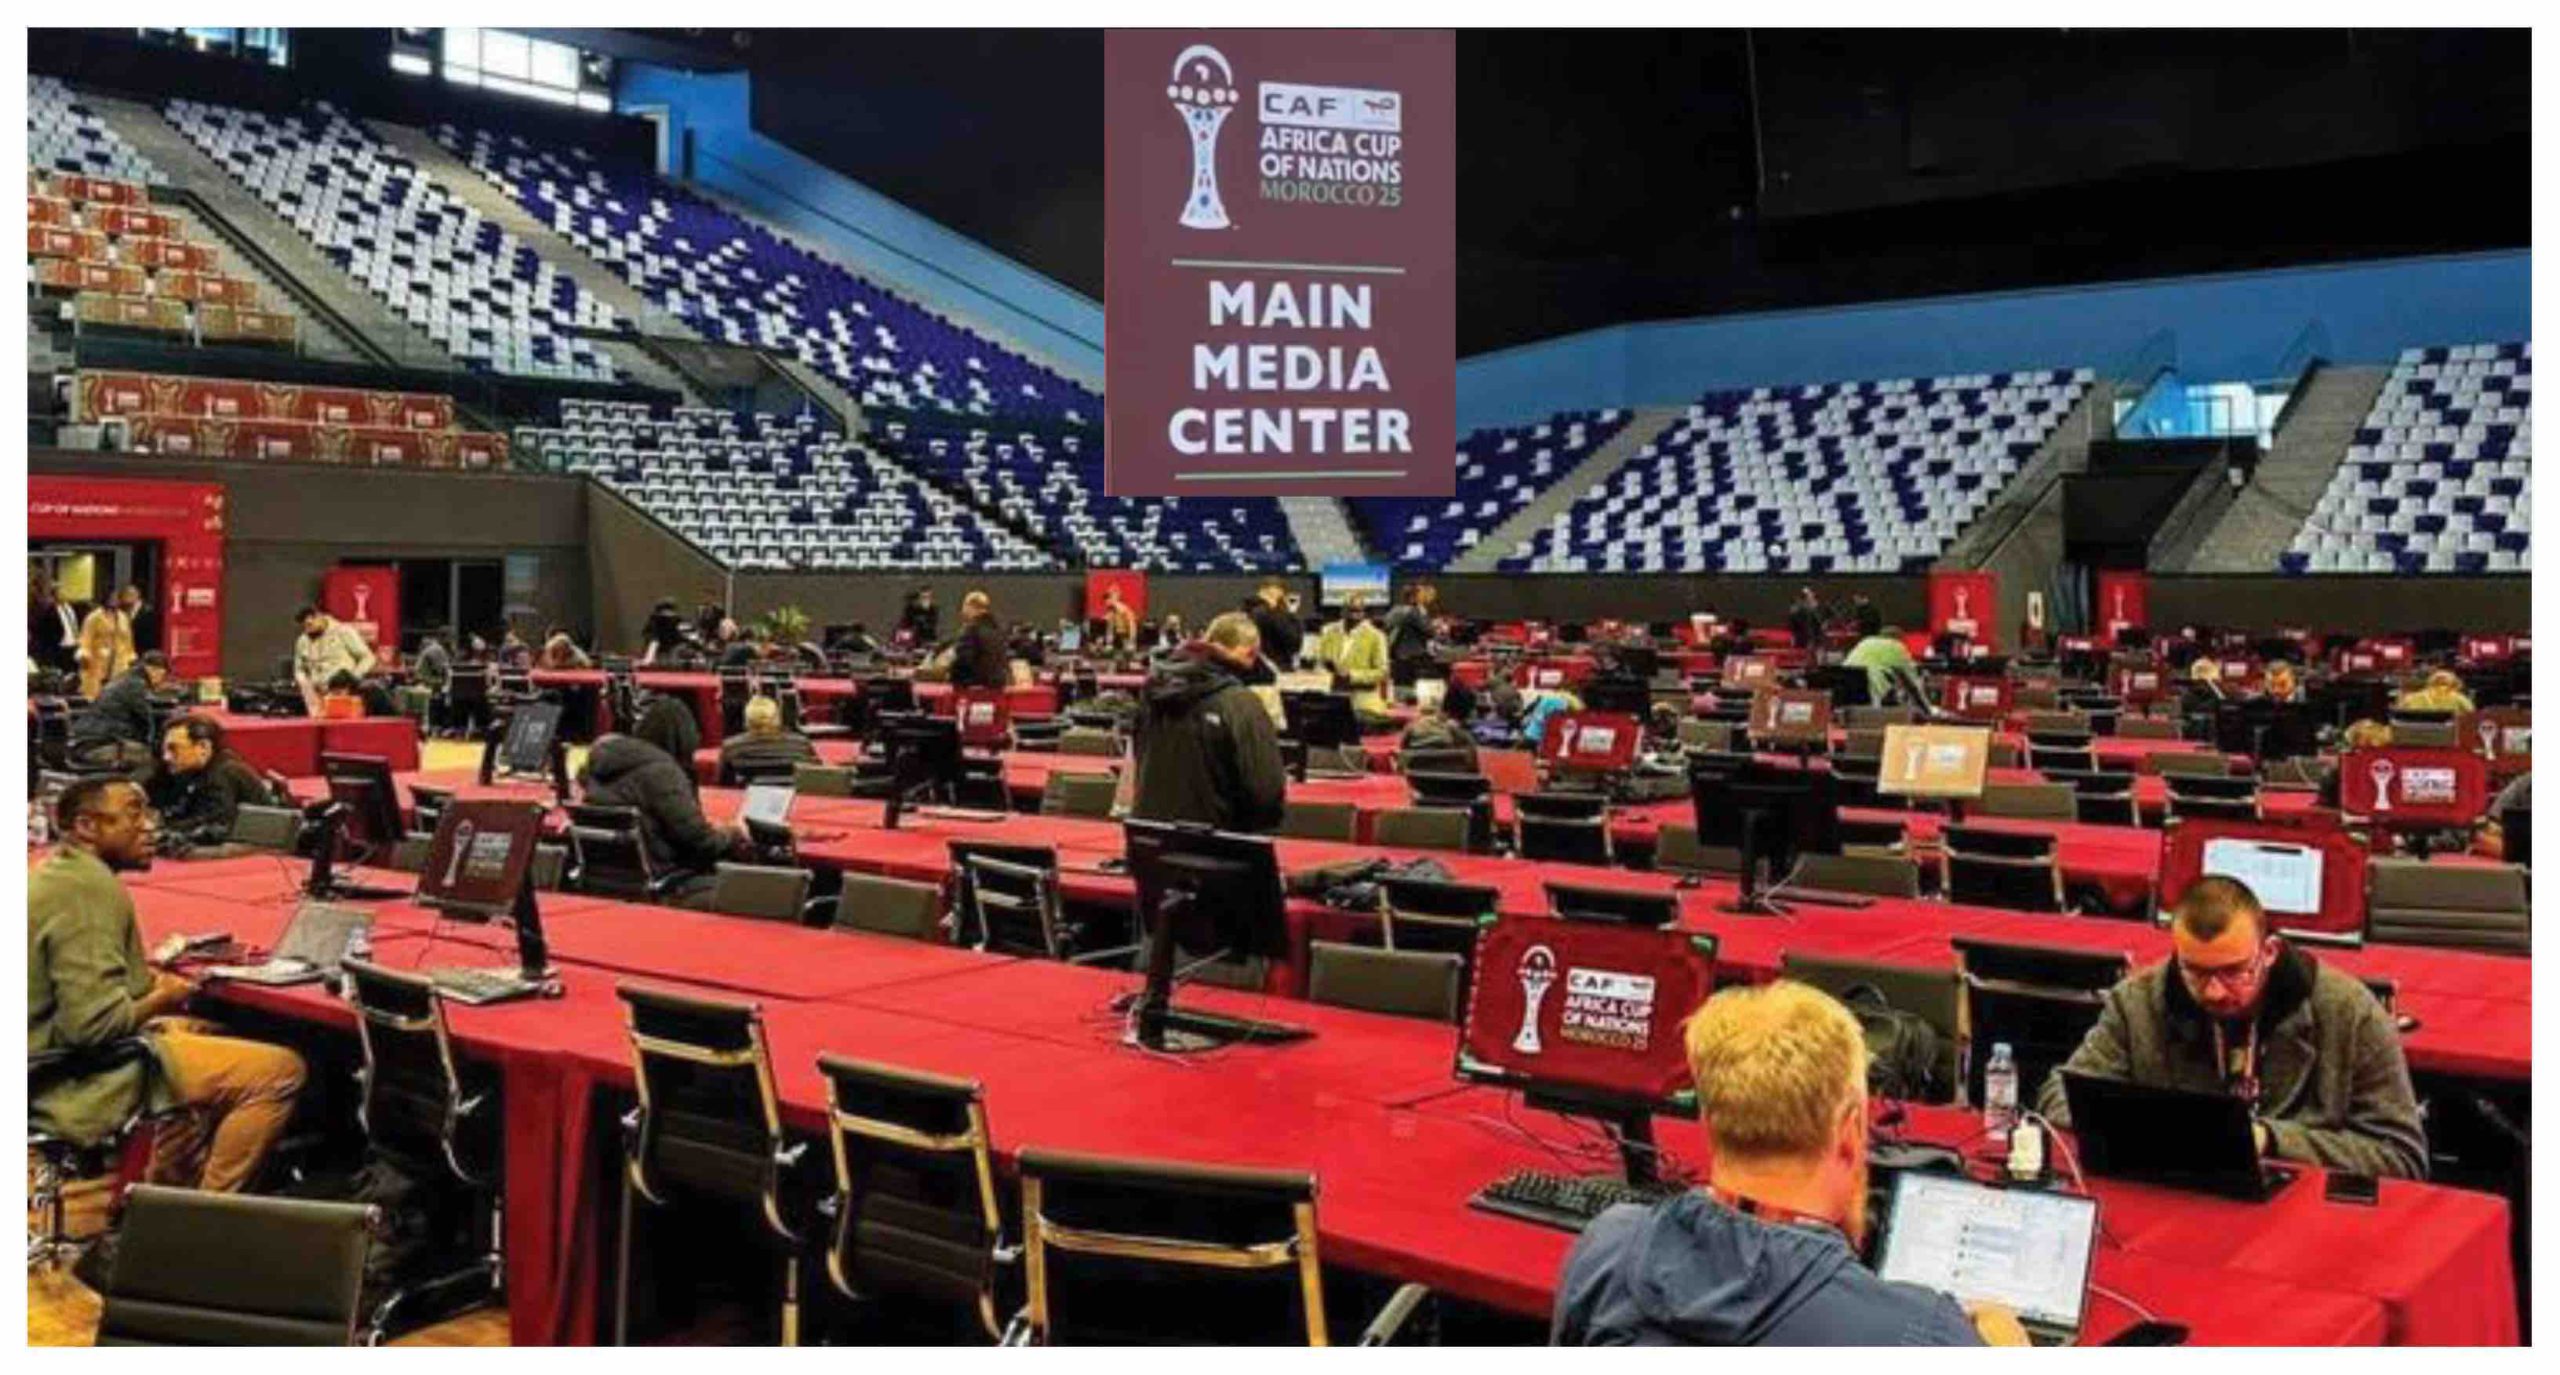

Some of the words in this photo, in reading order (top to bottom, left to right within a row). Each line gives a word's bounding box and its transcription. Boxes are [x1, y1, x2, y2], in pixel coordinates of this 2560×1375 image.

[1264, 93, 1337, 116] CAF
[1260, 126, 1348, 154] AFRICA
[1353, 133, 1402, 157] CUP
[1260, 153, 1295, 178] OF
[1298, 155, 1402, 183] NATIONS
[1260, 180, 1375, 205] MOROCCO
[1377, 186, 1402, 206] 25
[1209, 280, 1371, 329] MAIN
[1194, 343, 1390, 392] MEDIA
[1168, 407, 1413, 454] CENTER
[1570, 973, 1613, 990] CAF
[1565, 994, 1618, 1015] AFRICA
[1621, 1001, 1653, 1018] CUP
[1583, 1013, 1650, 1036] NATIONS
